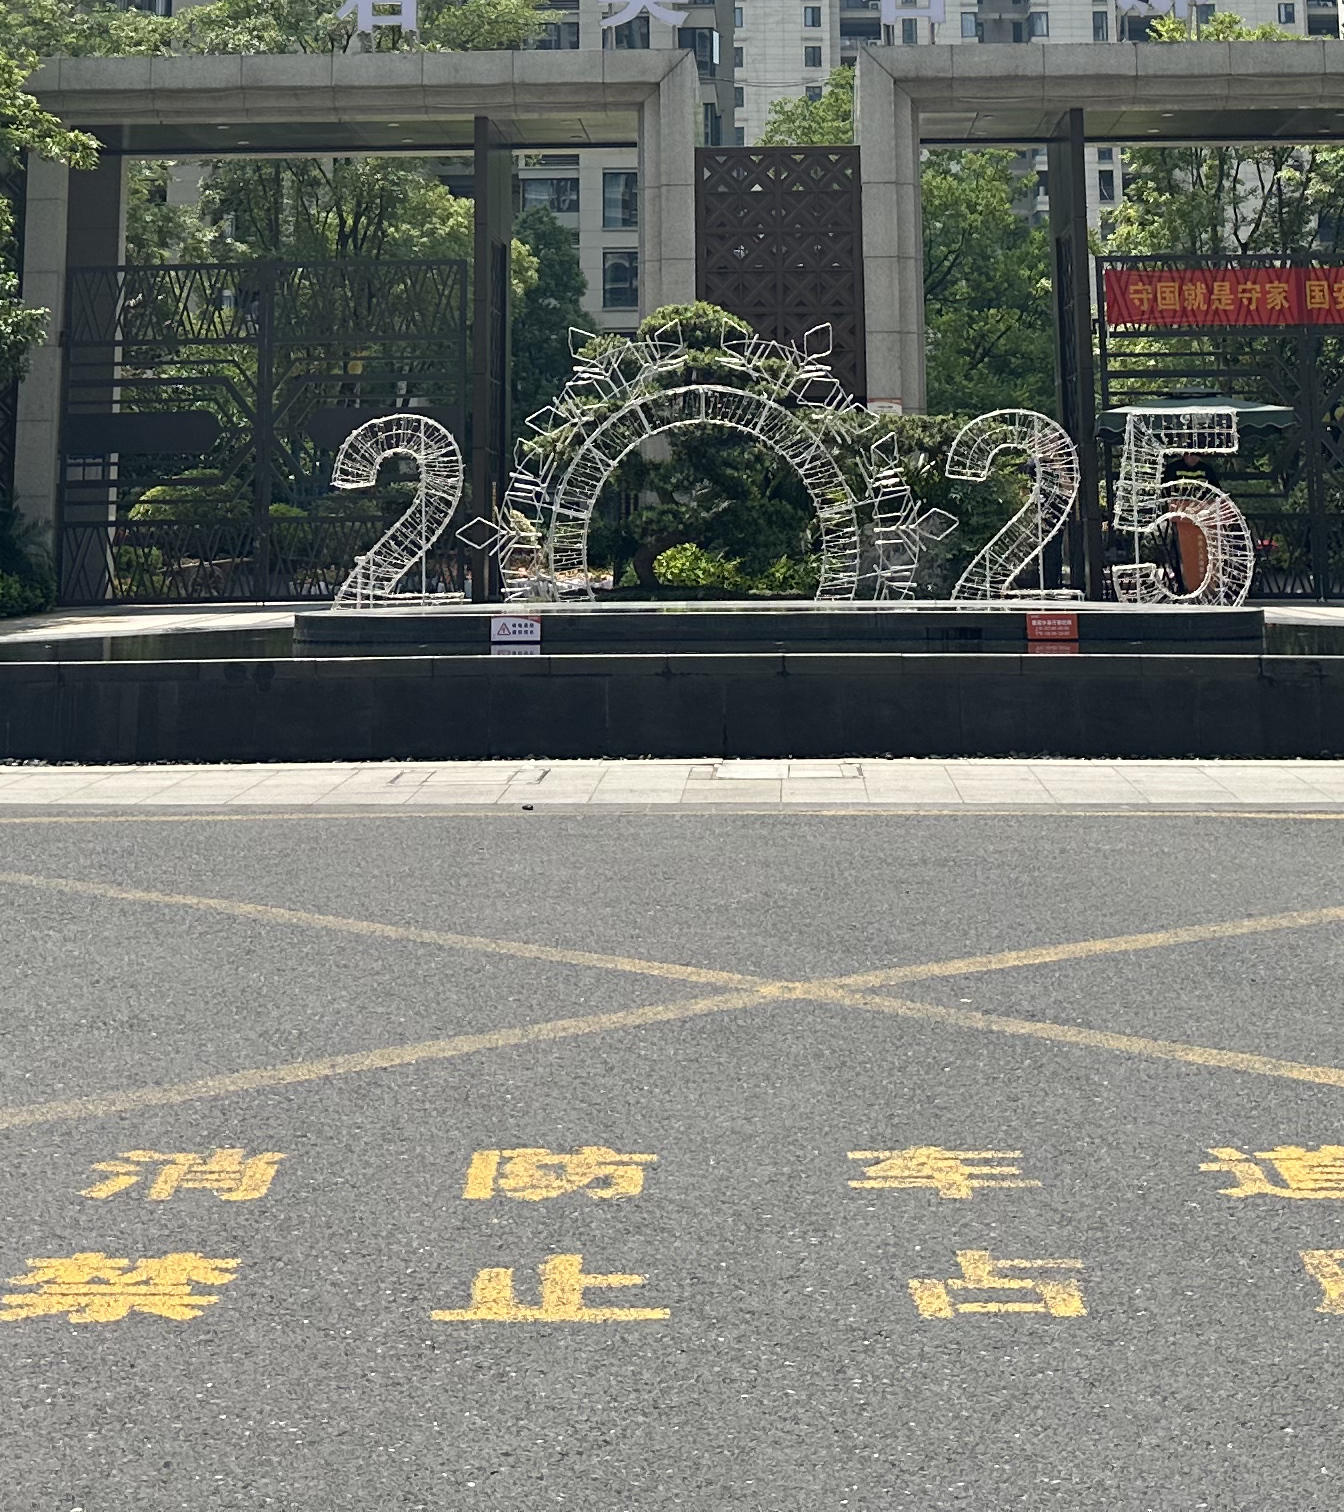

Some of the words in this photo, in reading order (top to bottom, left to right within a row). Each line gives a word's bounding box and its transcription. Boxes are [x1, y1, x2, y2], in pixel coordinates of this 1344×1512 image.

[1129, 279, 1291, 311] 守国就是守家
